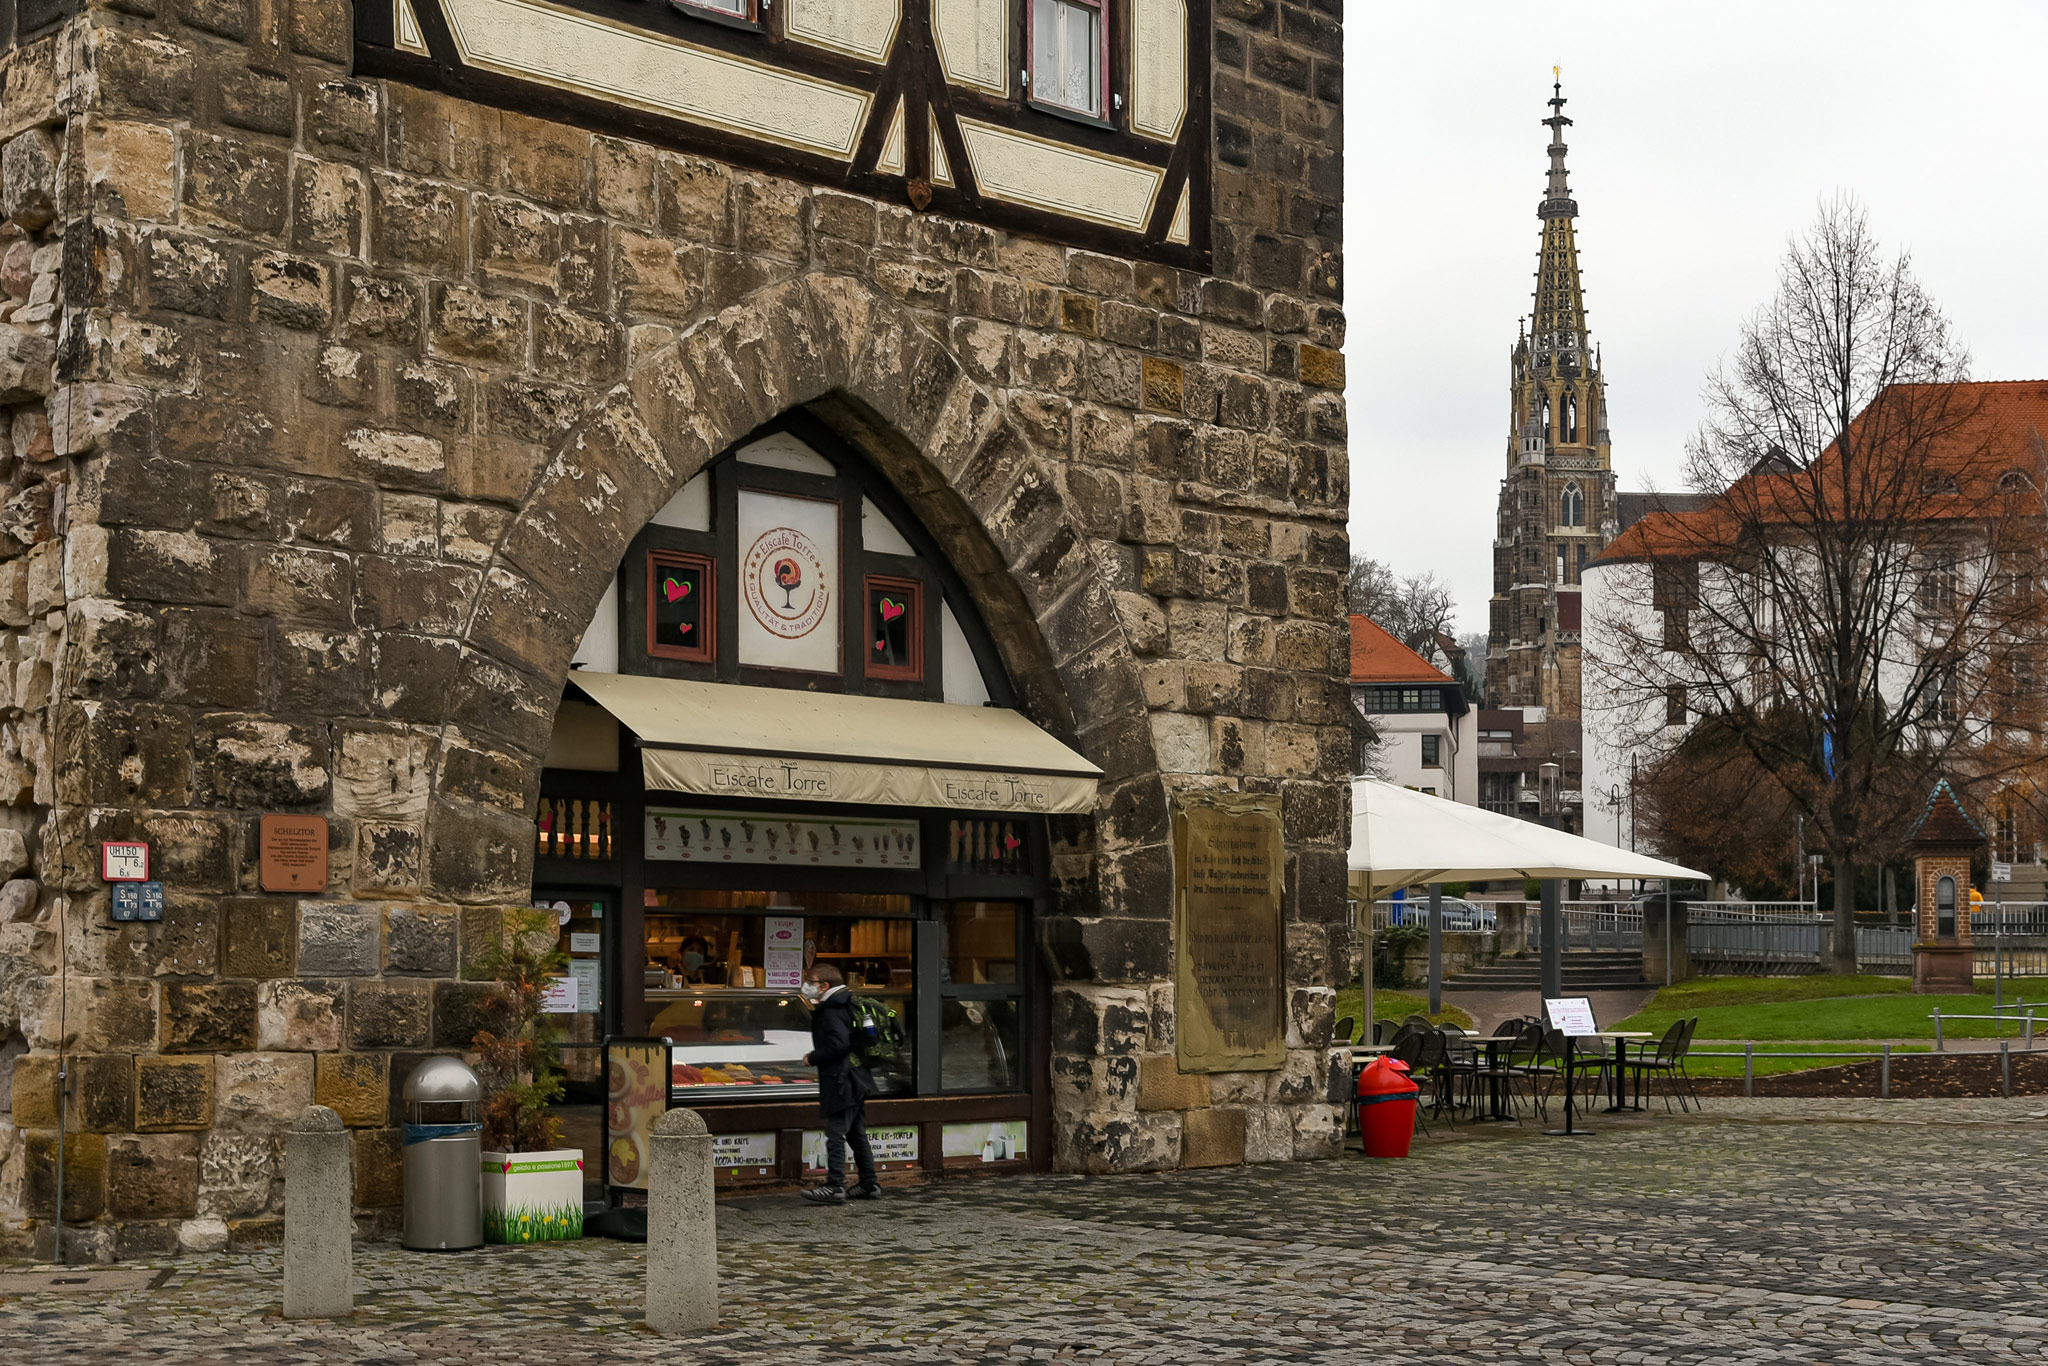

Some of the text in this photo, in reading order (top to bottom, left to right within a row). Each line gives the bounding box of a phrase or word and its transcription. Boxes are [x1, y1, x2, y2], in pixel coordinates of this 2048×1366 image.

[793, 534, 816, 562] Torre
[781, 621, 788, 632] &
[789, 591, 825, 632] TRADITION
[713, 764, 827, 791] Eiscafe Torre
[946, 779, 1044, 804] Eiscafe Torre
[273, 827, 316, 837] SCHELZTOR
[120, 889, 126, 899] S
[145, 889, 151, 899] S
[513, 1164, 531, 1172] gelato
